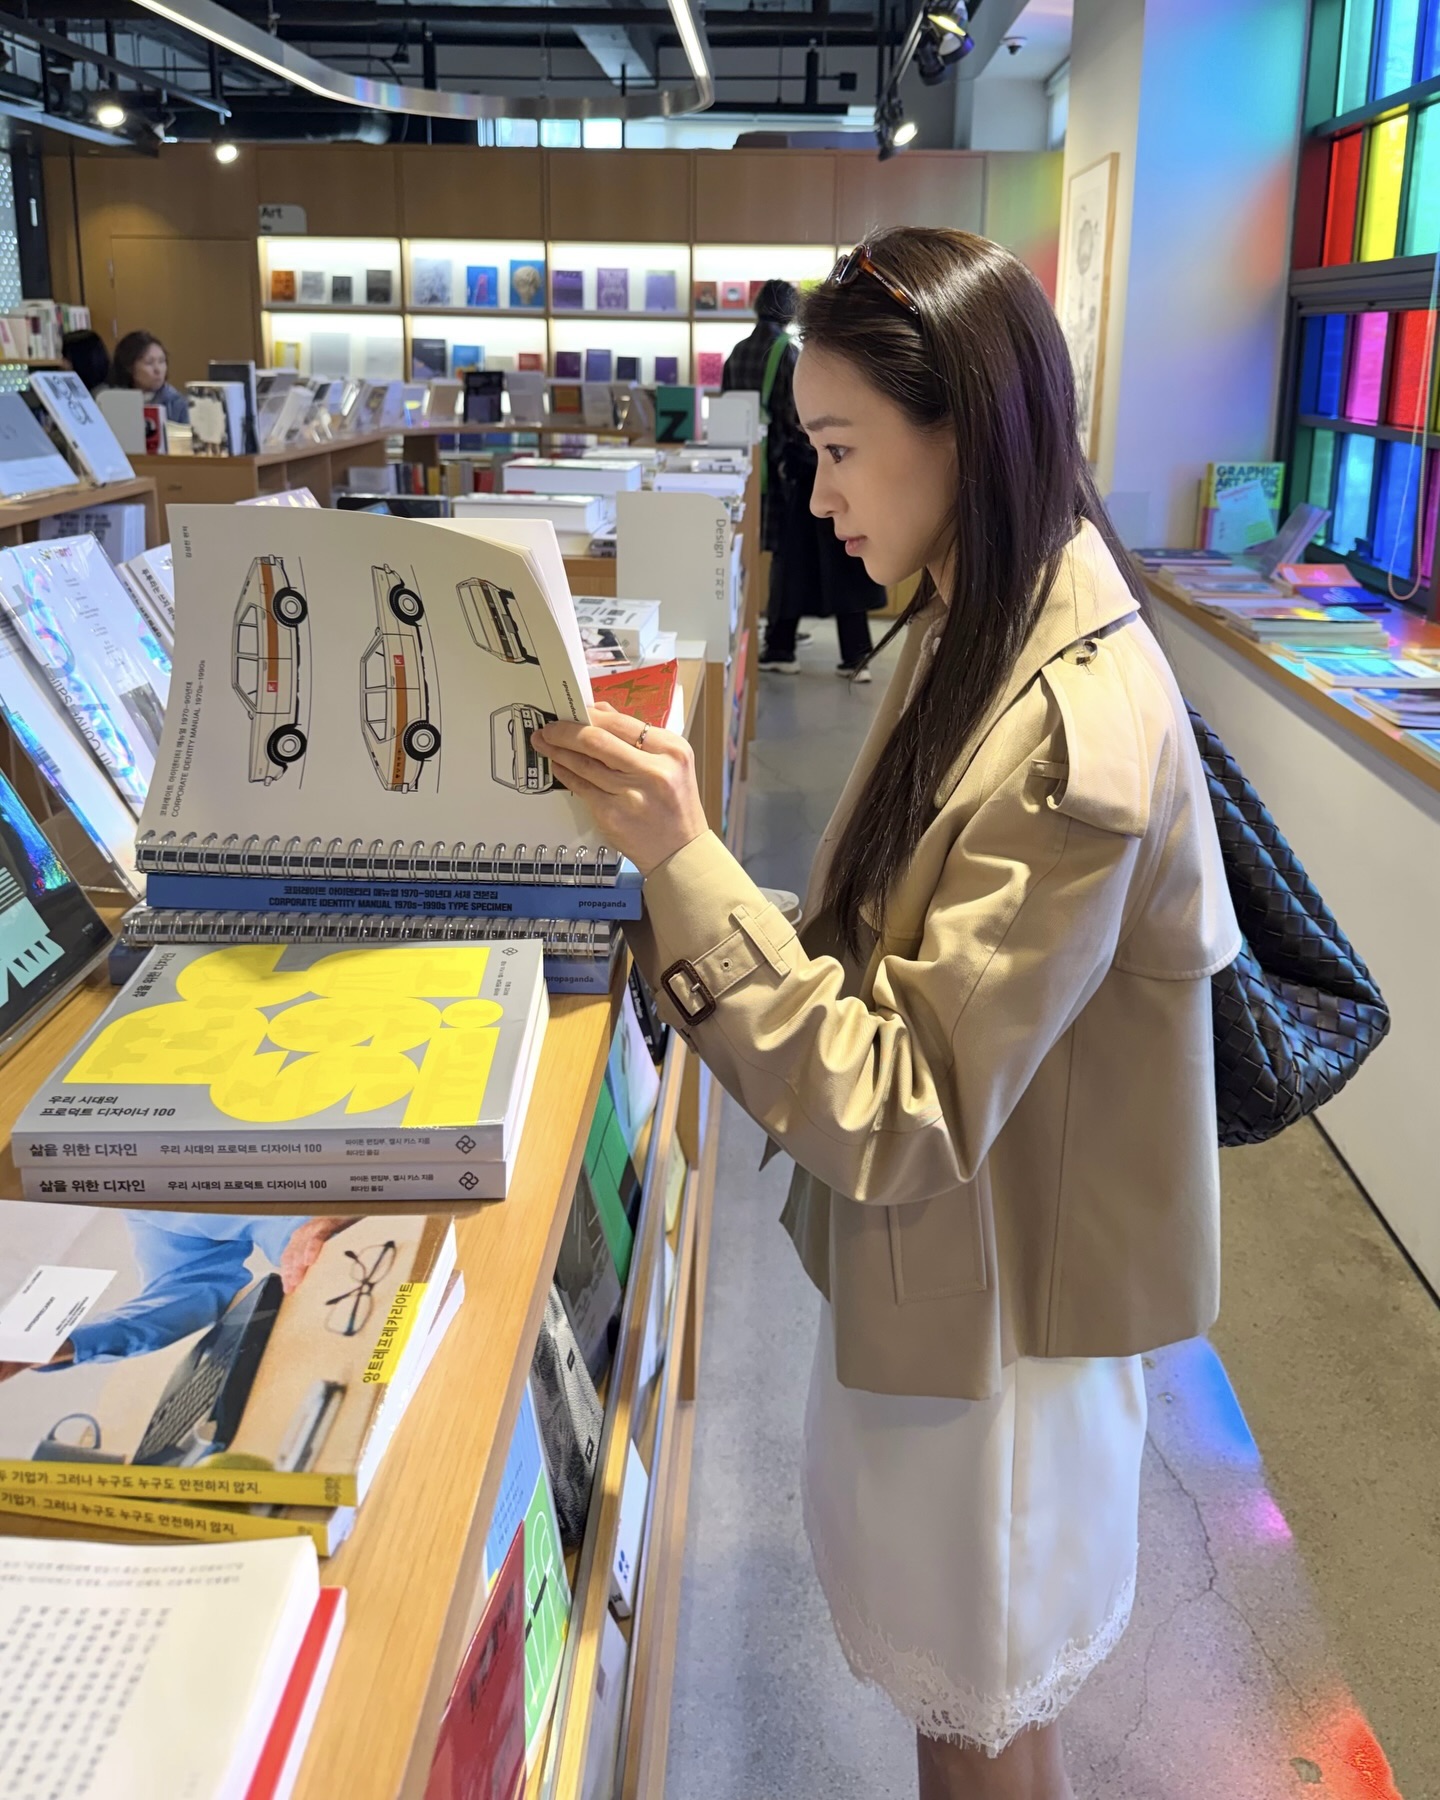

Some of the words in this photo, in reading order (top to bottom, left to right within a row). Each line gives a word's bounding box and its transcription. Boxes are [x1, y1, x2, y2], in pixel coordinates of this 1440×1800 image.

[262, 207, 283, 219] Art
[1216, 466, 1279, 477] GRAPHIC
[714, 518, 727, 559] Design
[562, 680, 580, 722] propaganda
[172, 772, 189, 818] CORPORATE
[183, 740, 197, 772] IDENTITY
[190, 708, 201, 738] MANUAL
[283, 886, 326, 895] 코퍼레이트
[328, 886, 371, 896] 아이덴티티
[454, 889, 471, 899] 서체
[269, 898, 317, 907] CORPORATE
[319, 899, 356, 908] IDENTITY
[358, 899, 392, 909] MANUAL
[394, 901, 447, 910] 1970s-1990s
[449, 902, 469, 910] TYPE
[471, 902, 513, 912] SPECIMEN
[578, 900, 627, 908] propaganda
[153, 952, 176, 970] 디자인
[142, 972, 162, 983] 위한
[546, 975, 594, 983] propaganda
[132, 985, 153, 997] 삶을
[48, 1096, 76, 1104] 우리
[78, 1096, 118, 1104] 시대의
[40, 1108, 93, 1116] 프로덕트
[97, 1107, 150, 1117] 디자이너
[152, 1108, 176, 1116] 100
[29, 1143, 58, 1157] 삶을
[62, 1143, 91, 1157] 위한
[95, 1143, 138, 1157] 디자인
[160, 1145, 180, 1154] 우리
[184, 1144, 214, 1154] 시대의
[217, 1144, 258, 1154] 프로덕트
[261, 1144, 302, 1153] 디자이너
[304, 1144, 322, 1153] 100
[39, 1180, 68, 1193] 삶을
[72, 1180, 99, 1193] 위한
[103, 1179, 146, 1193] 디자인
[168, 1181, 188, 1190] 우리
[191, 1181, 221, 1190] 시대의
[224, 1180, 264, 1190] 프로덕트
[267, 1180, 307, 1190] 디자이너
[309, 1180, 327, 1189] 100
[362, 1283, 414, 1384] 앙트레프레카리아트
[56, 1473, 93, 1486] 그러나
[97, 1475, 134, 1487] 누구도
[138, 1477, 175, 1489] 누구도
[179, 1478, 230, 1493] 안전하지
[43, 1498, 77, 1513] 그러나
[81, 1504, 117, 1518] 누구도
[120, 1510, 156, 1523] 누구도
[158, 1513, 207, 1531] 안전하지
